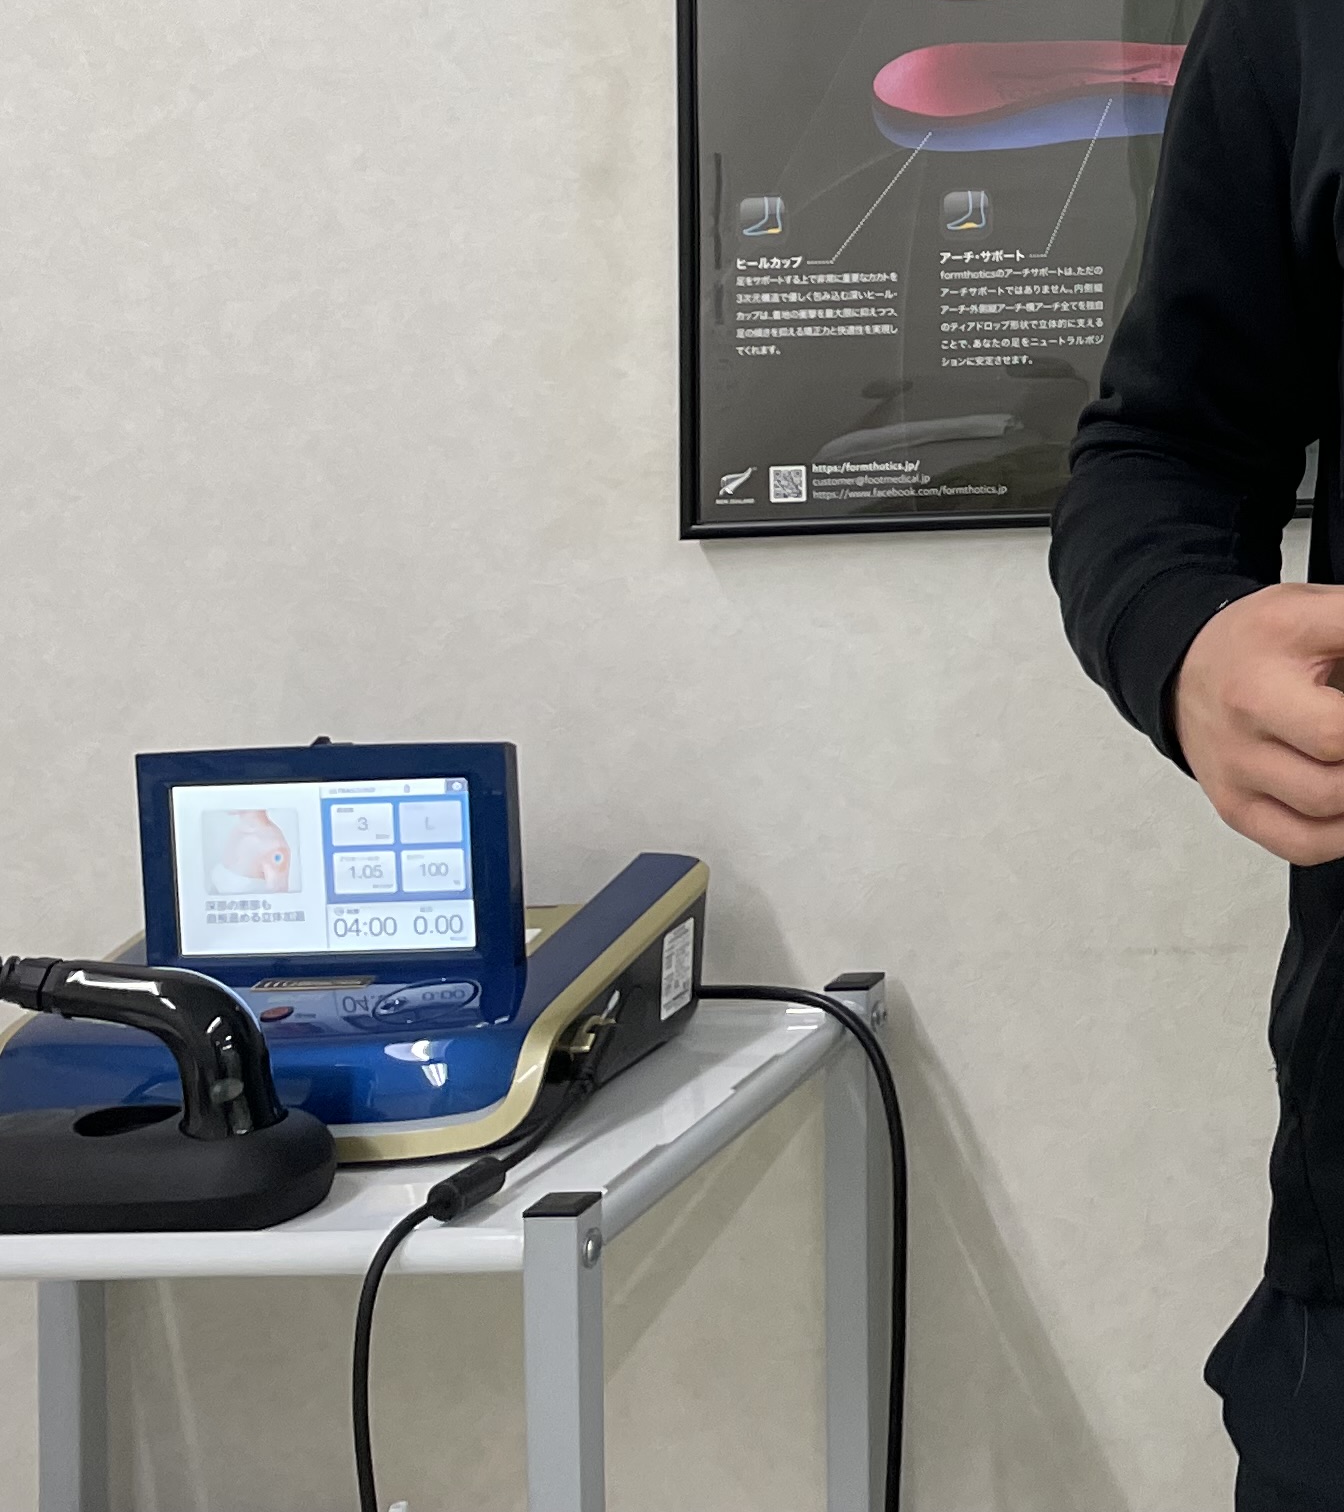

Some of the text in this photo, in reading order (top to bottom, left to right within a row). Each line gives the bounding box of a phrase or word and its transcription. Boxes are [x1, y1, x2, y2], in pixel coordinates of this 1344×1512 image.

[357, 816, 369, 831] 3
[348, 864, 383, 879] 1.05
[420, 862, 449, 878] 100
[333, 914, 464, 937] 04:00 0.00
